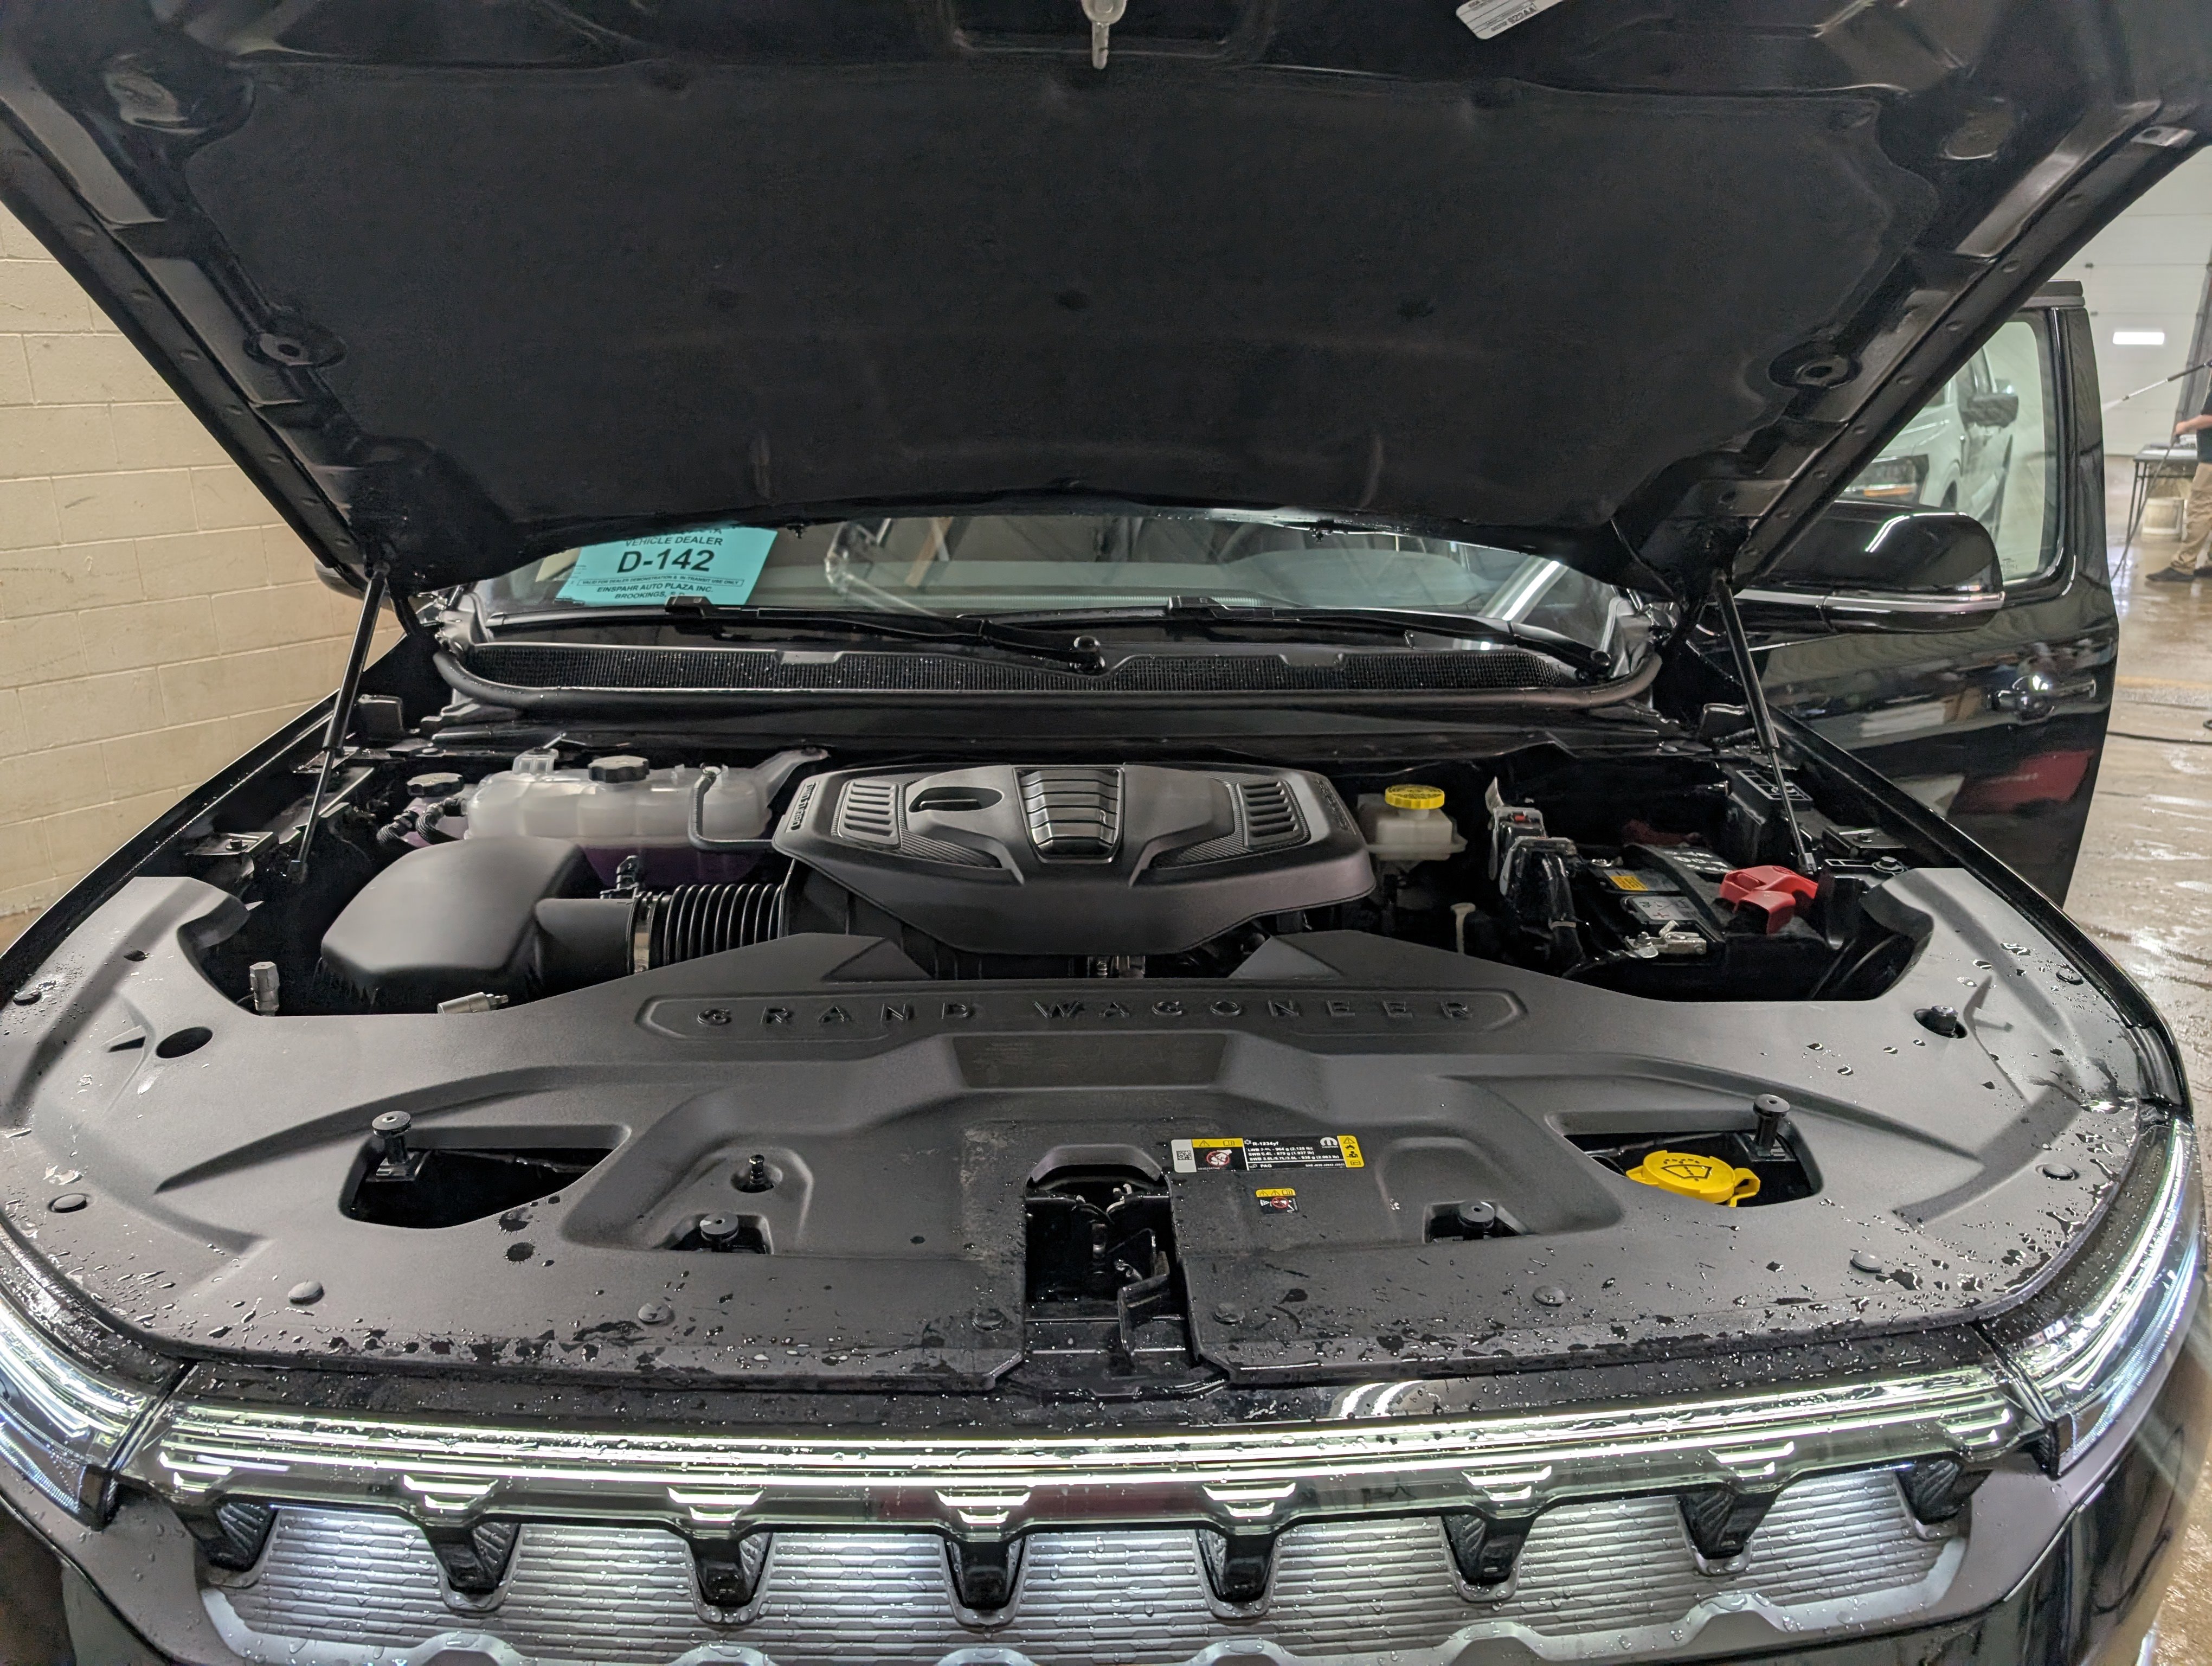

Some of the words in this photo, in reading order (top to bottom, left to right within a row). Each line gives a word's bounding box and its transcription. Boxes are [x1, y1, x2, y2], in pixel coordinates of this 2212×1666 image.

[626, 536, 672, 547] VEHICLE
[674, 536, 723, 546] DEALER
[617, 548, 715, 573] D-142
[665, 583, 694, 591] PLAZA
[697, 1002, 974, 1026] GRAND
[1033, 999, 1474, 1018] WAGONEER
